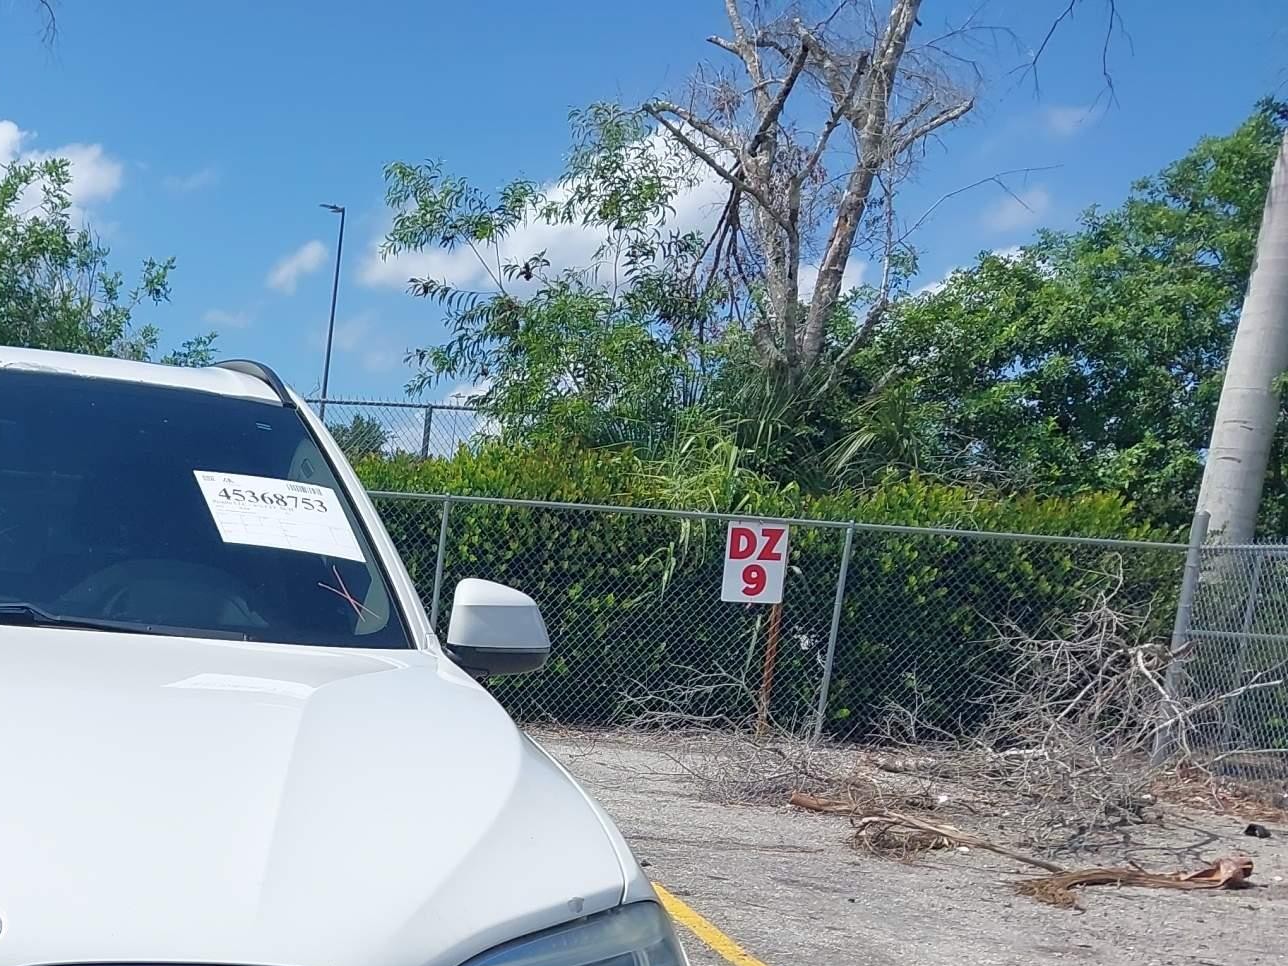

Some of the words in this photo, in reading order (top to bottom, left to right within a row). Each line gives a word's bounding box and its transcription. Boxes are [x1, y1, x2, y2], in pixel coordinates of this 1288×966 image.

[218, 487, 329, 513] 45368753
[728, 527, 786, 561] DZ
[741, 564, 767, 597] 9
